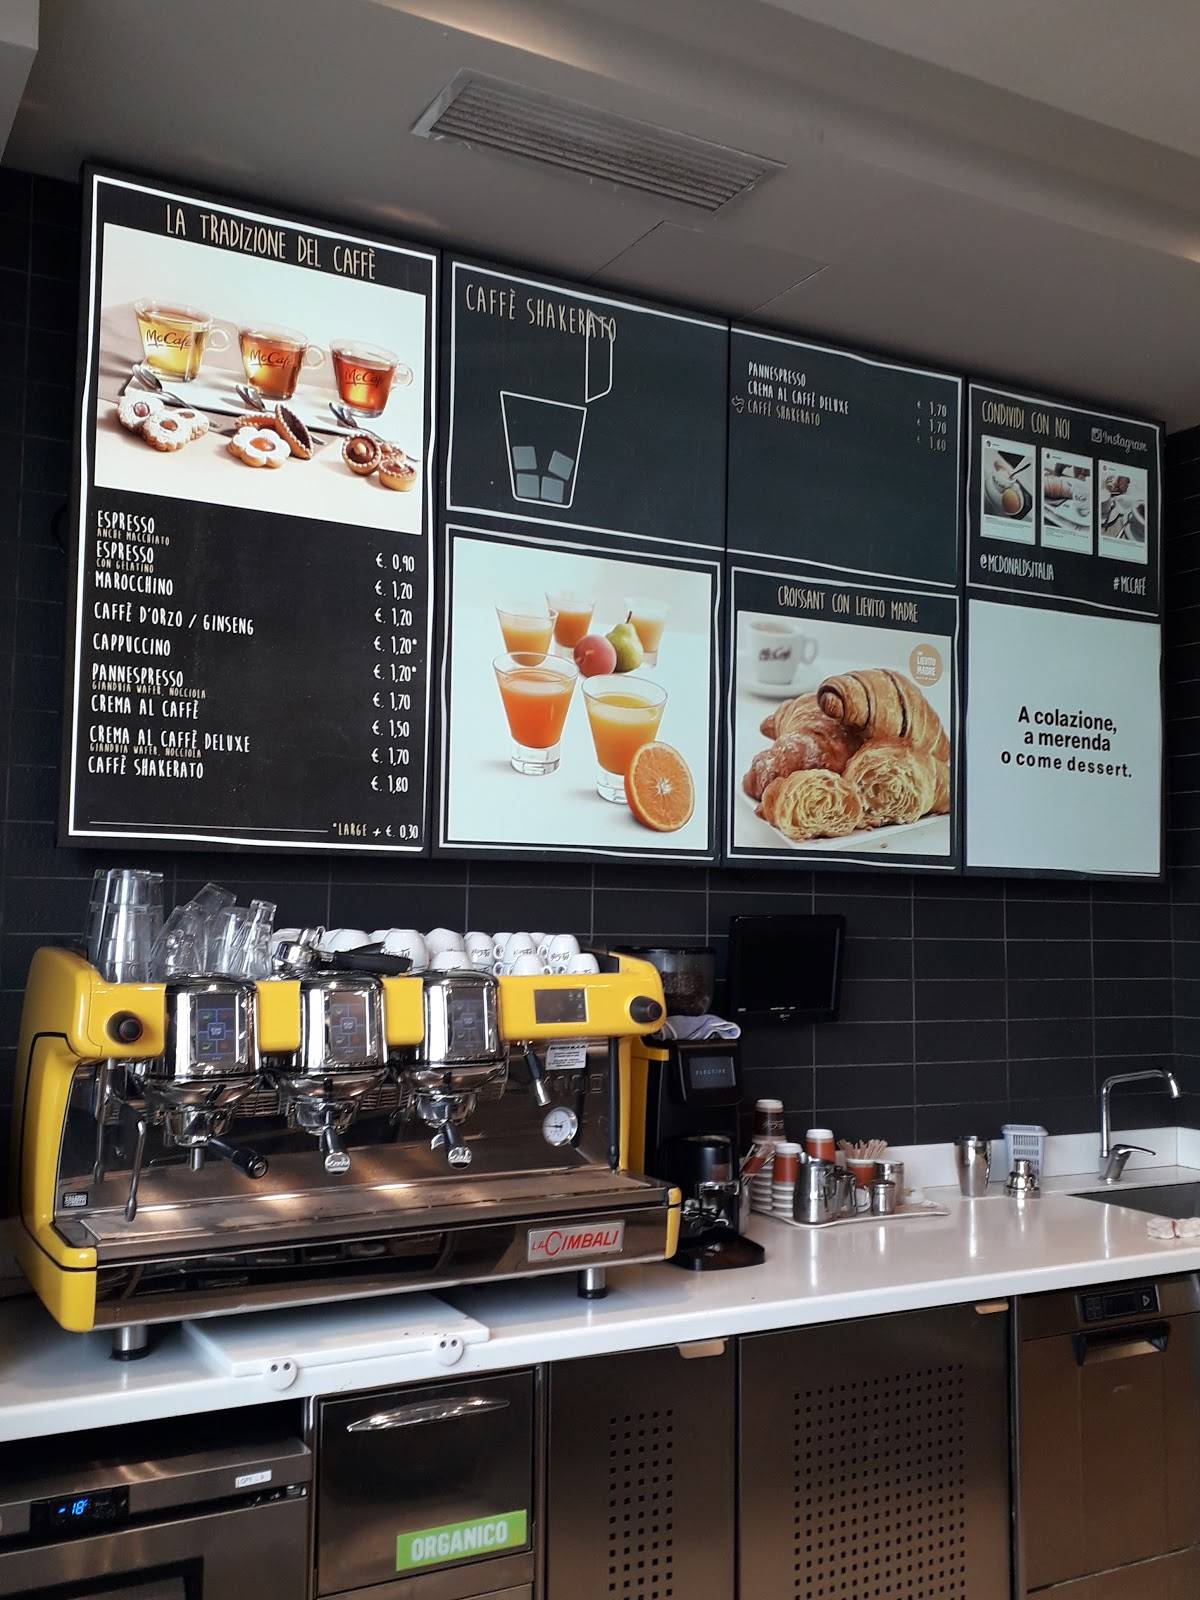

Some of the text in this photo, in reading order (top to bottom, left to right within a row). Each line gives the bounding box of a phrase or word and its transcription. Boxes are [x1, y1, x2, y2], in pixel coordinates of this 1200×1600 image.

[167, 204, 375, 280] LA TRADIZIONE DEL CAFFÈ
[466, 284, 616, 342] CAFFÈ SHAKERATO
[748, 361, 806, 387] PANNESPRESSO
[748, 380, 774, 398] CREMA
[778, 386, 788, 402] AL
[820, 396, 848, 414] DELUXE
[776, 405, 820, 426] SHAKERATO
[930, 402, 947, 417] 1,70
[982, 400, 1071, 440] CONDIVIDI CON NOI
[930, 419, 946, 434] 1,70
[1102, 431, 1148, 453] Instagram
[98, 510, 154, 534] ESPRESSO
[96, 540, 154, 564] ESPRESSO
[96, 558, 112, 568] CON
[392, 554, 414, 572] 0,90
[96, 570, 173, 596] MAROCCHINO
[392, 580, 412, 600] 1,20
[778, 586, 918, 623] CROISSANT CON LIEVITO MADRE
[94, 602, 254, 635] CAFFÈ D'ORZO / GINSENG
[392, 608, 412, 626] 1,20
[93, 632, 170, 656] CAPPUCCINO
[92, 663, 184, 688] PANNESPRESSO
[91, 694, 199, 720] CREMA AL CAFFÈ
[390, 692, 410, 711] 1,70
[389, 720, 409, 738] 1,50
[1018, 706, 1117, 734] A colazione,
[90, 724, 250, 753] CREMA AL CAFFÈ DELUXE
[1024, 731, 1110, 752] a merenda
[88, 755, 204, 779] CAFFÈ SHAKERATO
[388, 748, 409, 766] 1,70
[1001, 751, 1132, 778] o come dessert.
[388, 776, 408, 794] 1,80
[372, 827, 381, 836] +
[400, 824, 418, 840] 0,30
[532, 1230, 619, 1256] LA CIMBALI
[411, 1521, 508, 1562] ORGANICO
